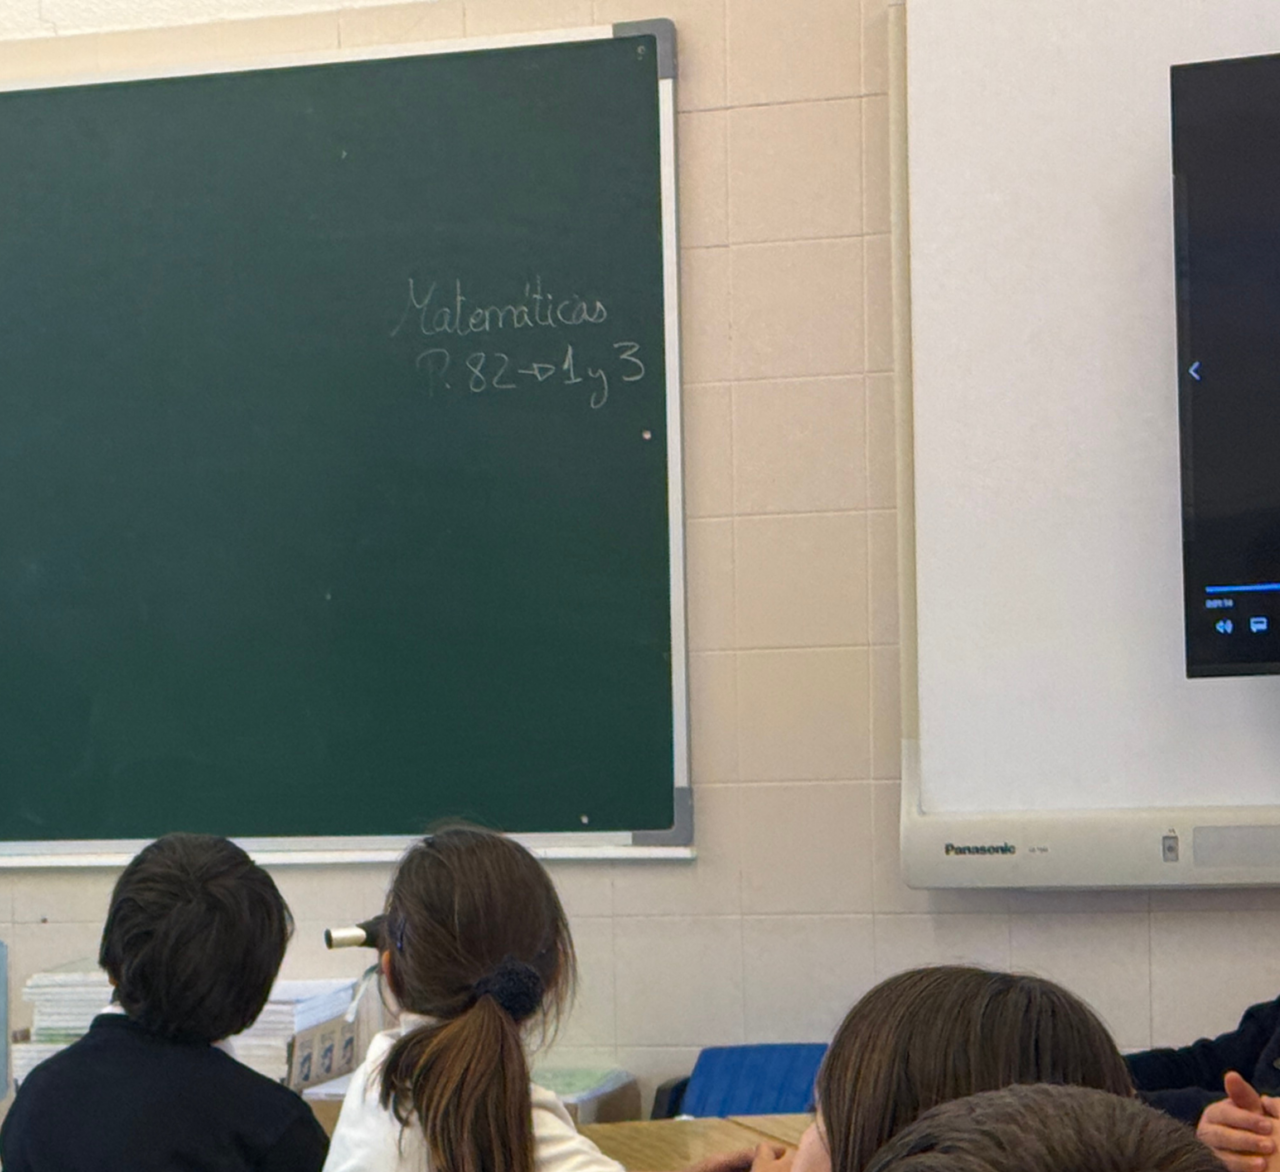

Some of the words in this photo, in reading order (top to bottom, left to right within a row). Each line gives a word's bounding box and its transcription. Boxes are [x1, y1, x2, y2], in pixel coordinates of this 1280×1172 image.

[465, 352, 517, 393] 82
[562, 344, 583, 384] 1
[587, 367, 609, 409] y
[613, 341, 646, 382] 3
[944, 842, 1017, 855] Panasonic
